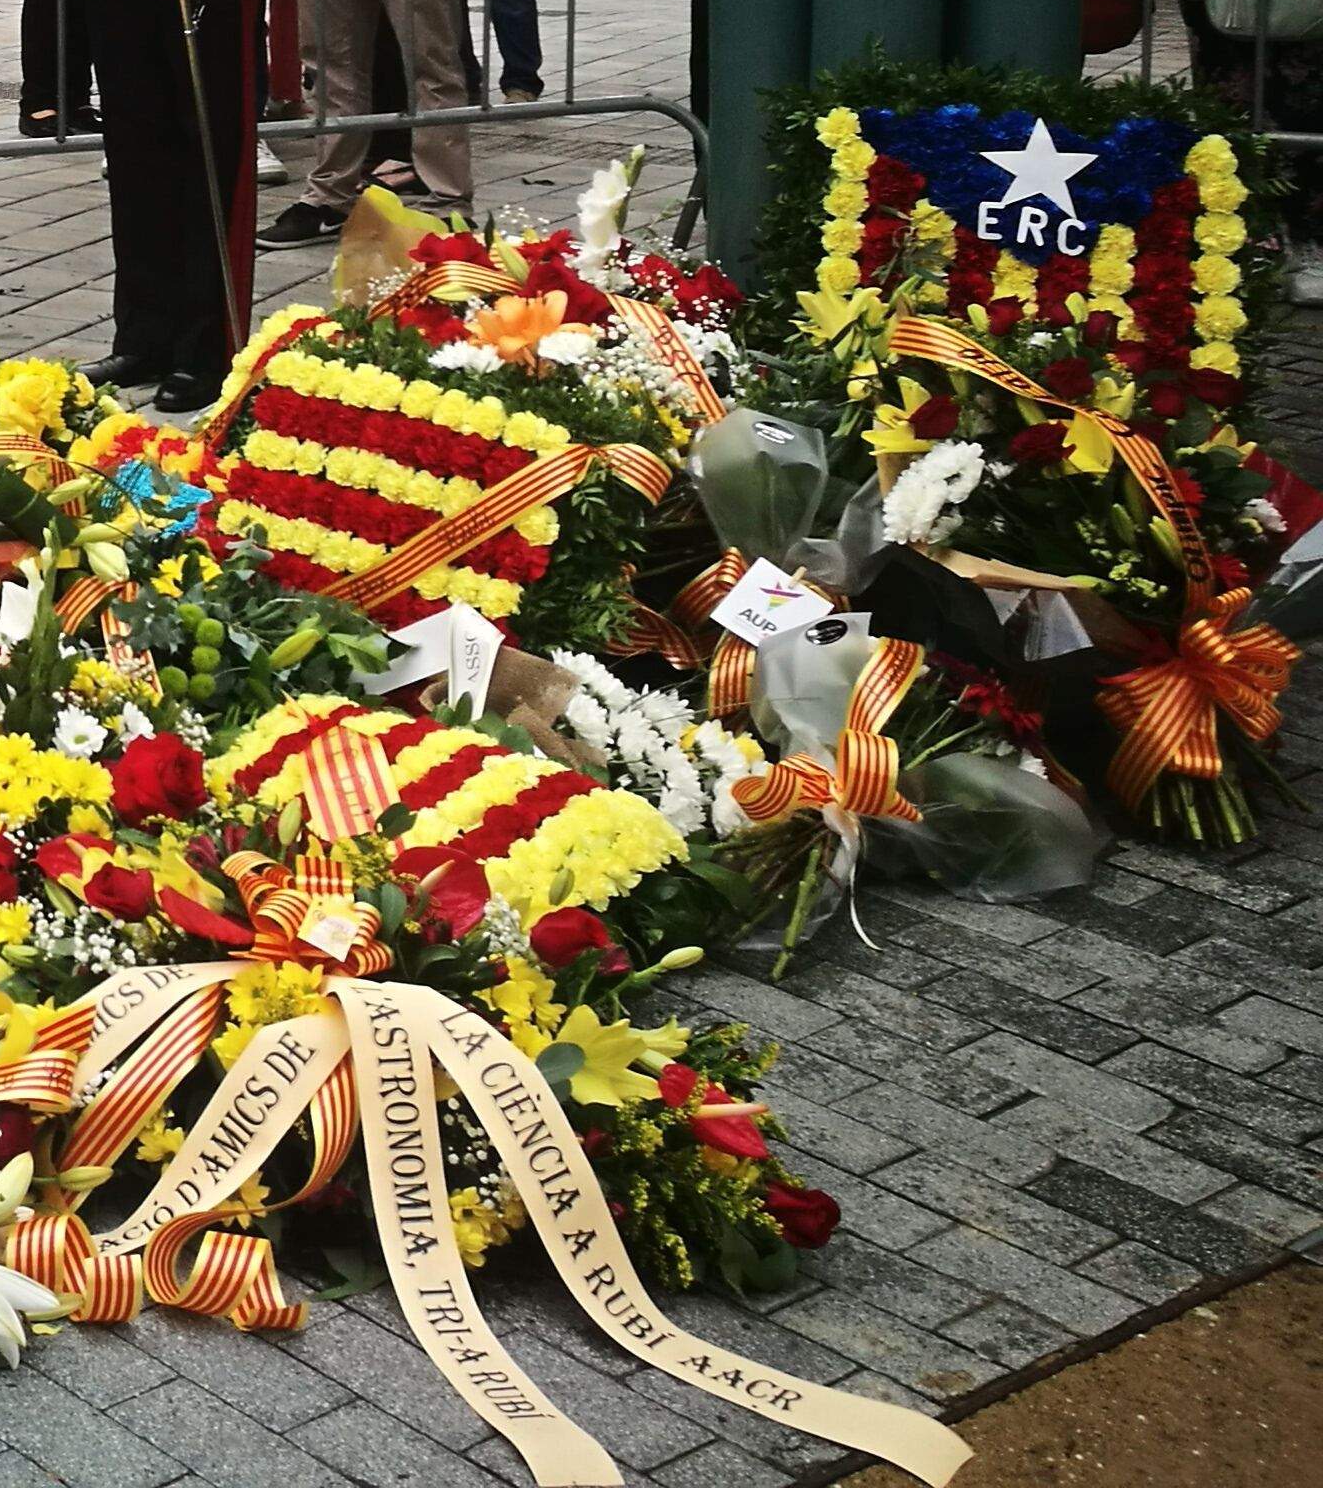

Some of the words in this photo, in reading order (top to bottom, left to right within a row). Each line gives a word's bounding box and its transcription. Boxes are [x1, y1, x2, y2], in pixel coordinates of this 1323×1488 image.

[977, 201, 1087, 256] ERC
[144, 963, 195, 991] DE
[175, 1075, 280, 1208] D'AMICS
[264, 1030, 317, 1087] DE
[439, 1011, 492, 1059] LA
[480, 1062, 583, 1222] CIÈNCIA
[562, 1227, 598, 1261] A
[583, 1262, 677, 1351] RUBÍ
[675, 1354, 804, 1412] AACR
[469, 1369, 556, 1423] RUBÍ
